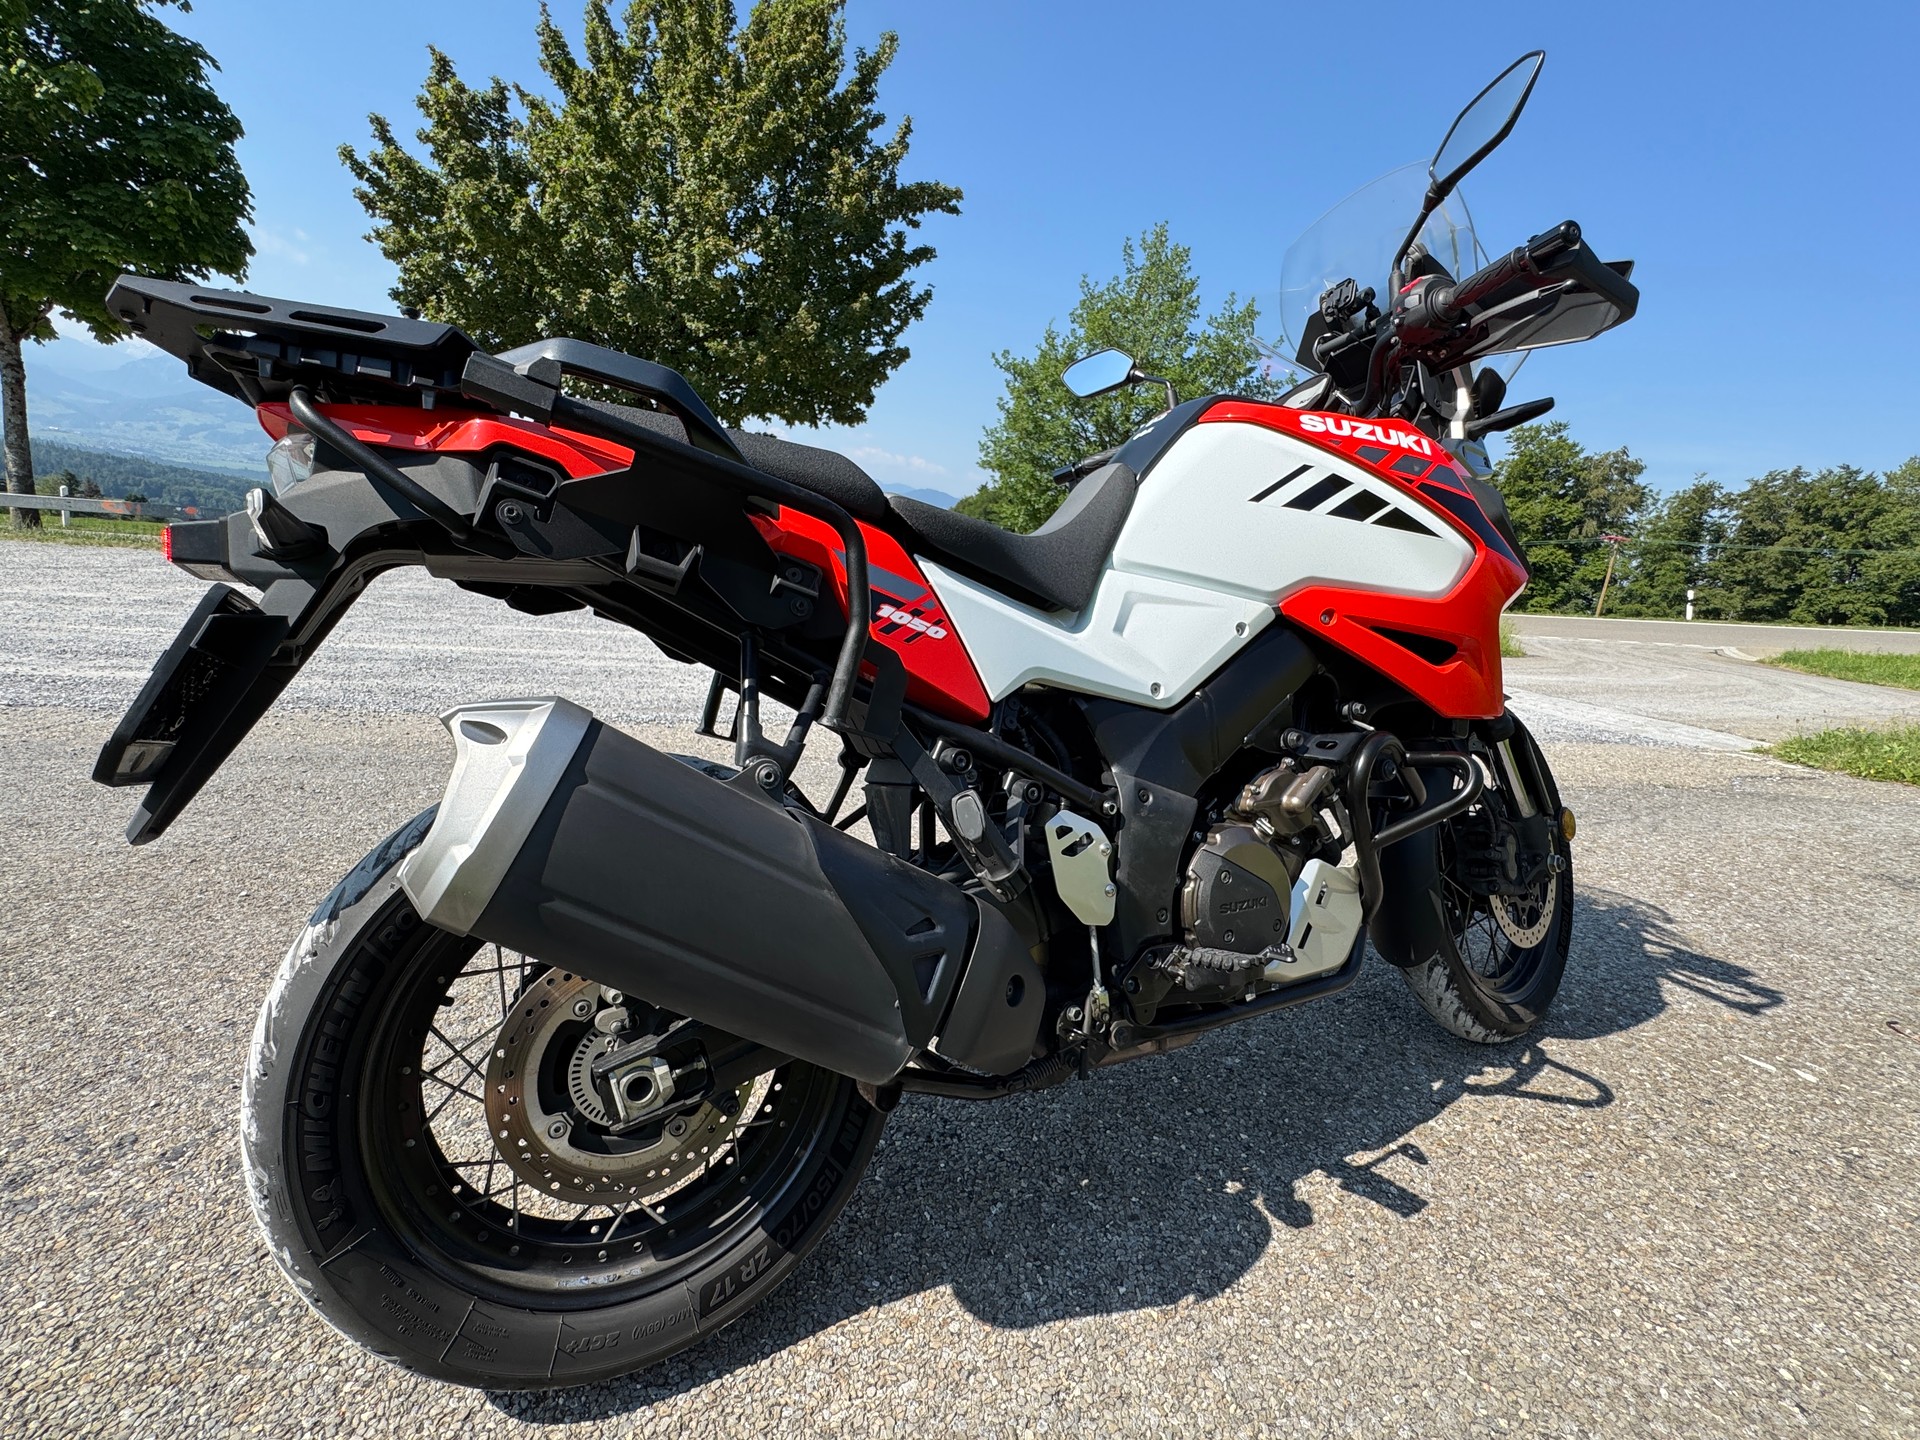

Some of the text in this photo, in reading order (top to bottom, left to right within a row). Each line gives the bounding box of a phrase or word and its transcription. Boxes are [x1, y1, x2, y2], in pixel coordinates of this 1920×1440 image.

[1299, 414, 1432, 456] SUZUKI
[876, 603, 948, 640] 1050
[1219, 896, 1268, 914] SUZUKI
[303, 907, 416, 1172] MICHELIN RO
[709, 1167, 838, 1307] 150/70 ZR 17
[565, 1331, 621, 1354] 2CT+
